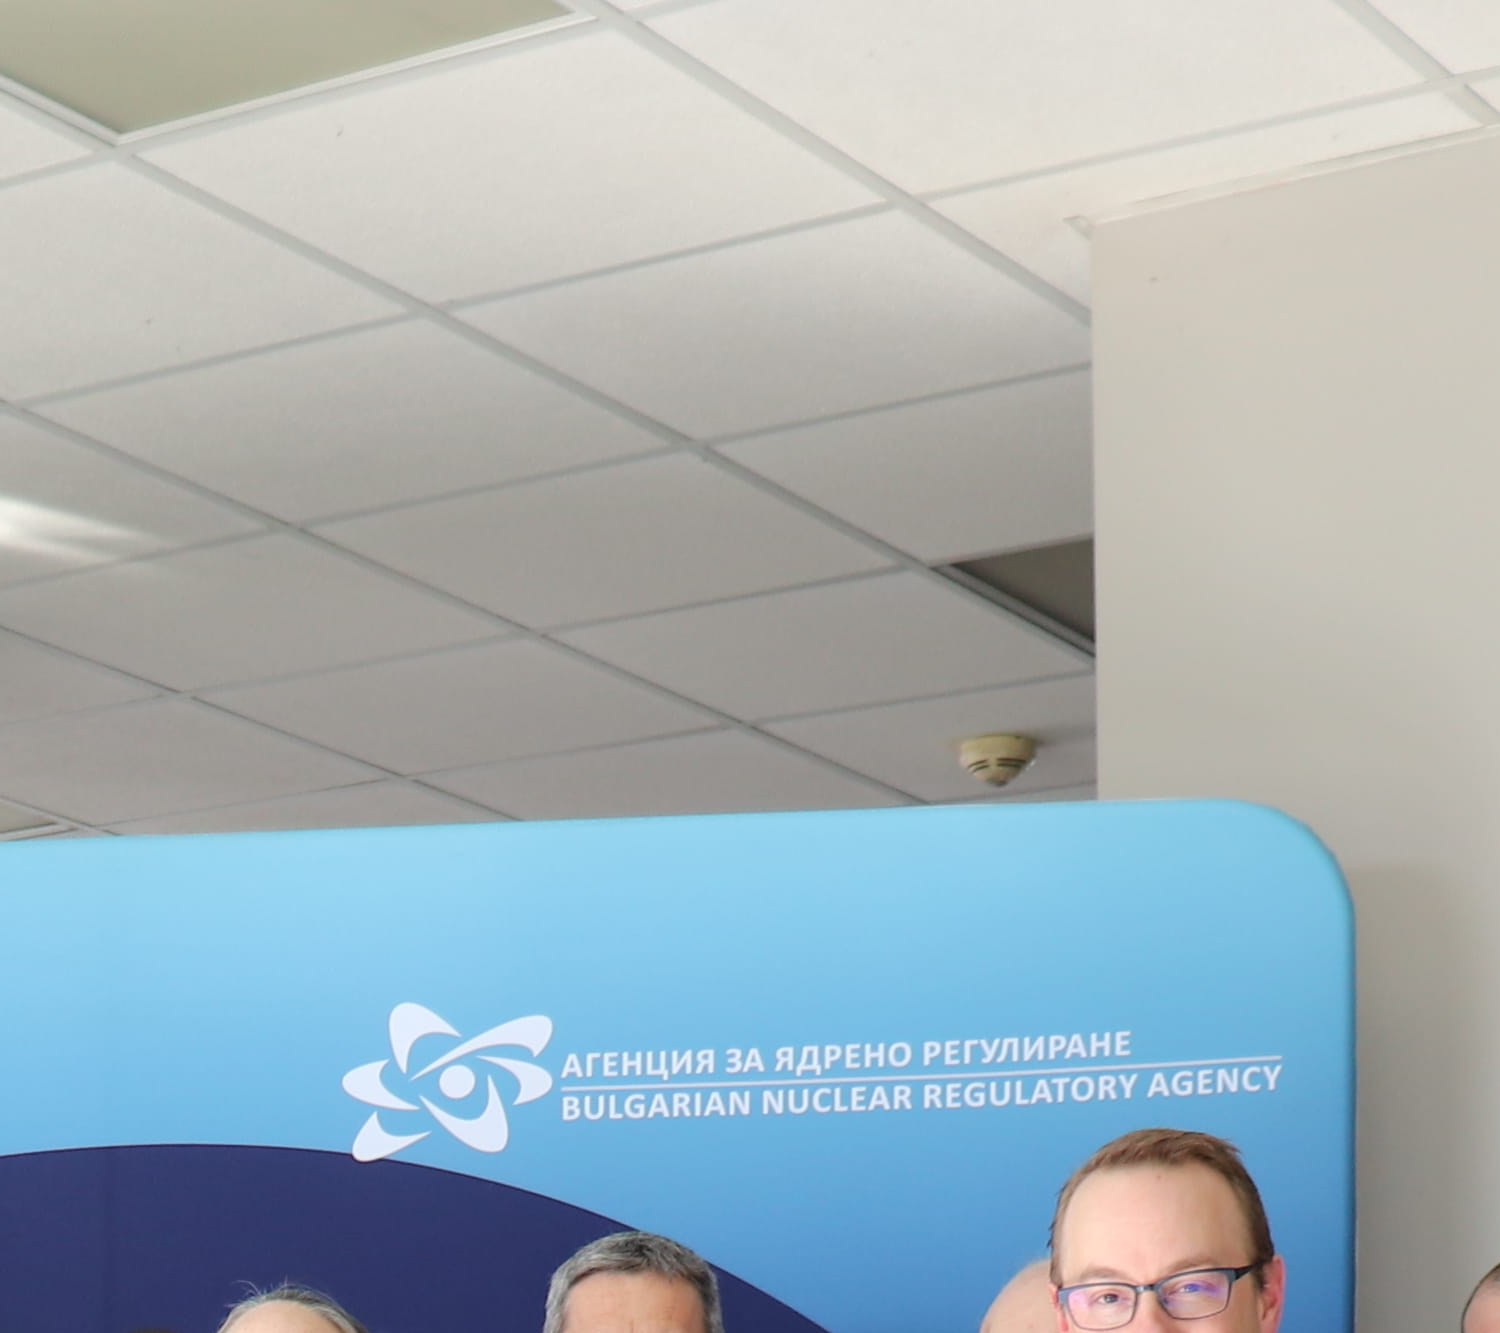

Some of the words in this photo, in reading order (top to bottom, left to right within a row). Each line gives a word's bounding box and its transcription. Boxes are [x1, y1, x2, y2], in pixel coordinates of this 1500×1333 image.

[560, 1049, 715, 1081] АГЕНЦИЯ
[725, 1048, 764, 1074] ЗА
[775, 1042, 912, 1077] ЯДРЕНО
[923, 1030, 1132, 1067] РЕГУЛИРАНЕ
[561, 1091, 751, 1121] BULGARIAN
[762, 1085, 912, 1115] NUCLEAR
[923, 1074, 1138, 1109] REGULATORY
[1147, 1065, 1282, 1099] AGENCY
